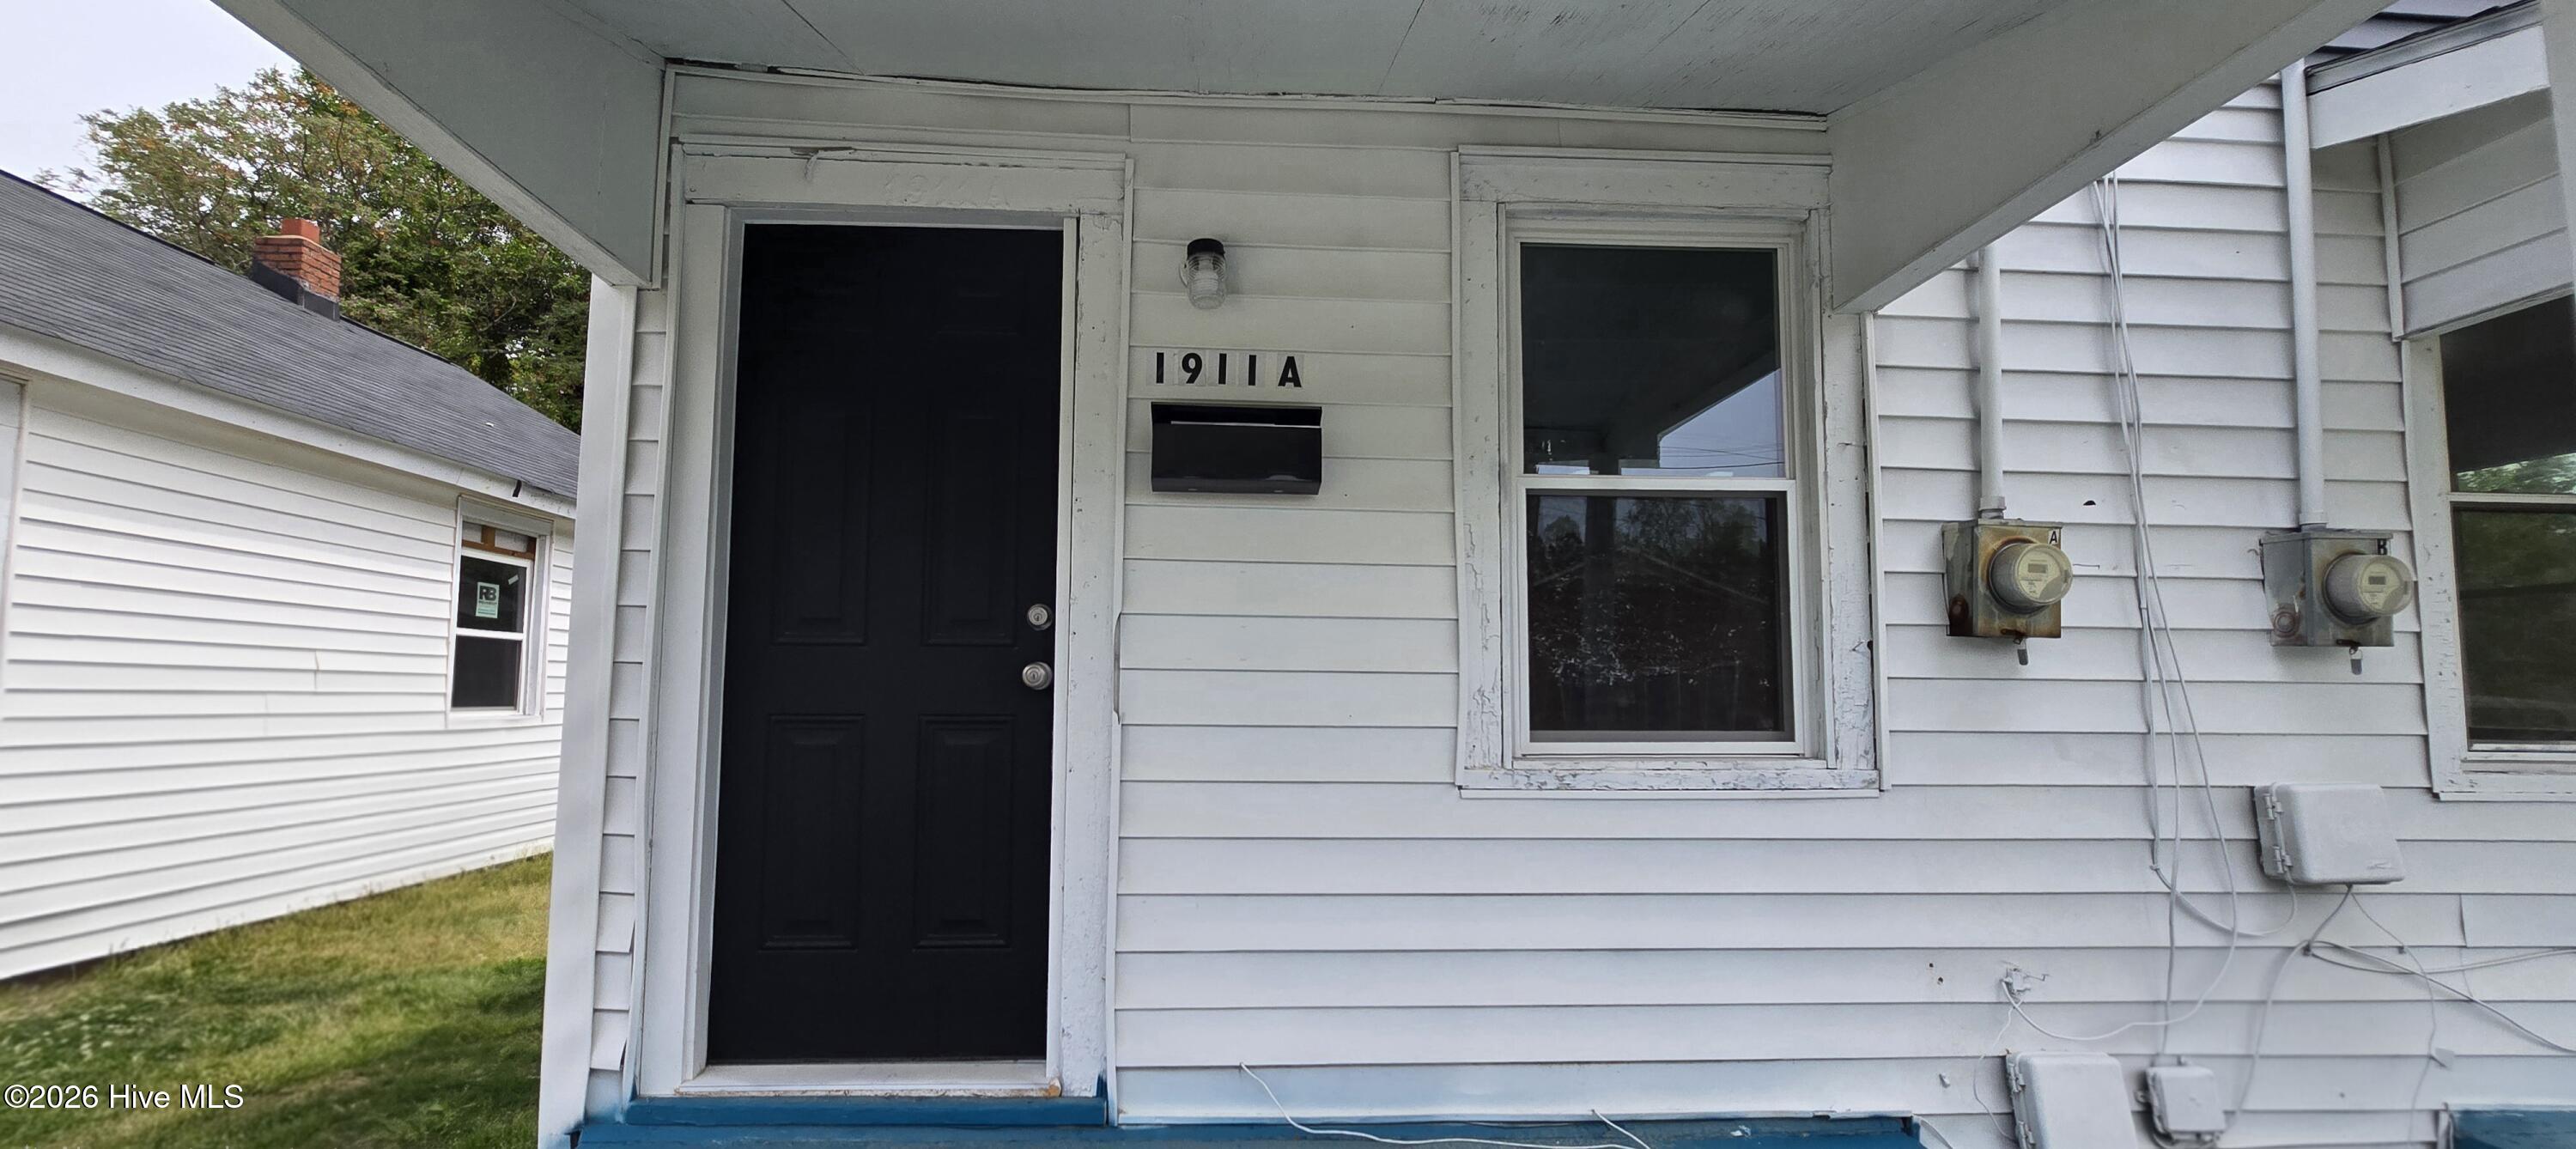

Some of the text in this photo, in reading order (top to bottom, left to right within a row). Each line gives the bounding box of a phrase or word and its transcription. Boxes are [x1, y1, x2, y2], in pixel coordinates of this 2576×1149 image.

[2049, 531, 2058, 544] A
[2377, 538, 2388, 555] B
[479, 585, 497, 601] RB
